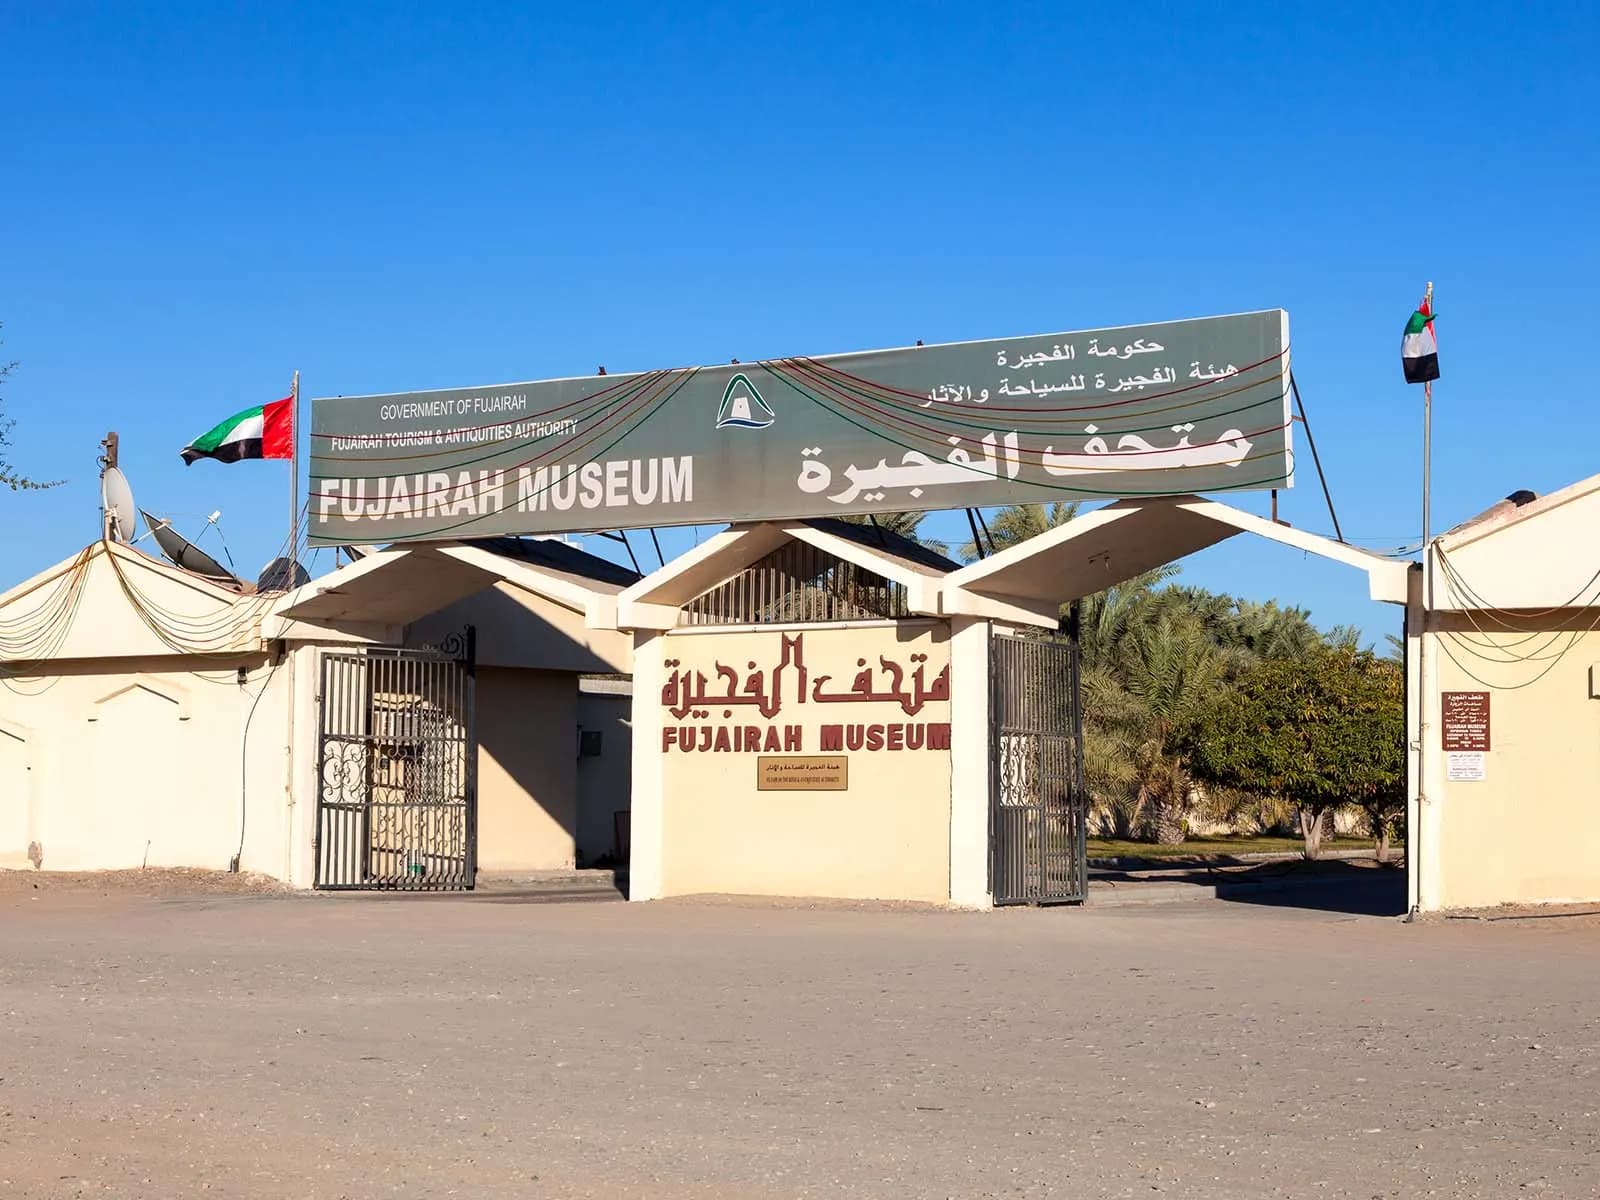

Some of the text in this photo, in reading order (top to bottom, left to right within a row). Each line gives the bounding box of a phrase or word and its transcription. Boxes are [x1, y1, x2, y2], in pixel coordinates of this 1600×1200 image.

[997, 338, 1164, 367] حكومة الفجيرة
[1097, 367, 1177, 391] الفجيرة
[1189, 360, 1239, 382] هيئة
[999, 374, 1085, 398] للسياحة
[381, 395, 527, 421] GOVERNMENT OF FUJAIRAH
[331, 419, 578, 451] FUJAIRAH TOURISM & ANTIQUITIES AUTHORITY
[797, 423, 1254, 503] متحف الفجيرة
[319, 456, 693, 523] FUJAIRAH MUSEUM
[661, 632, 949, 719] متحف الفجيرة
[662, 723, 951, 752] FUJAIRAH MUSEUM
